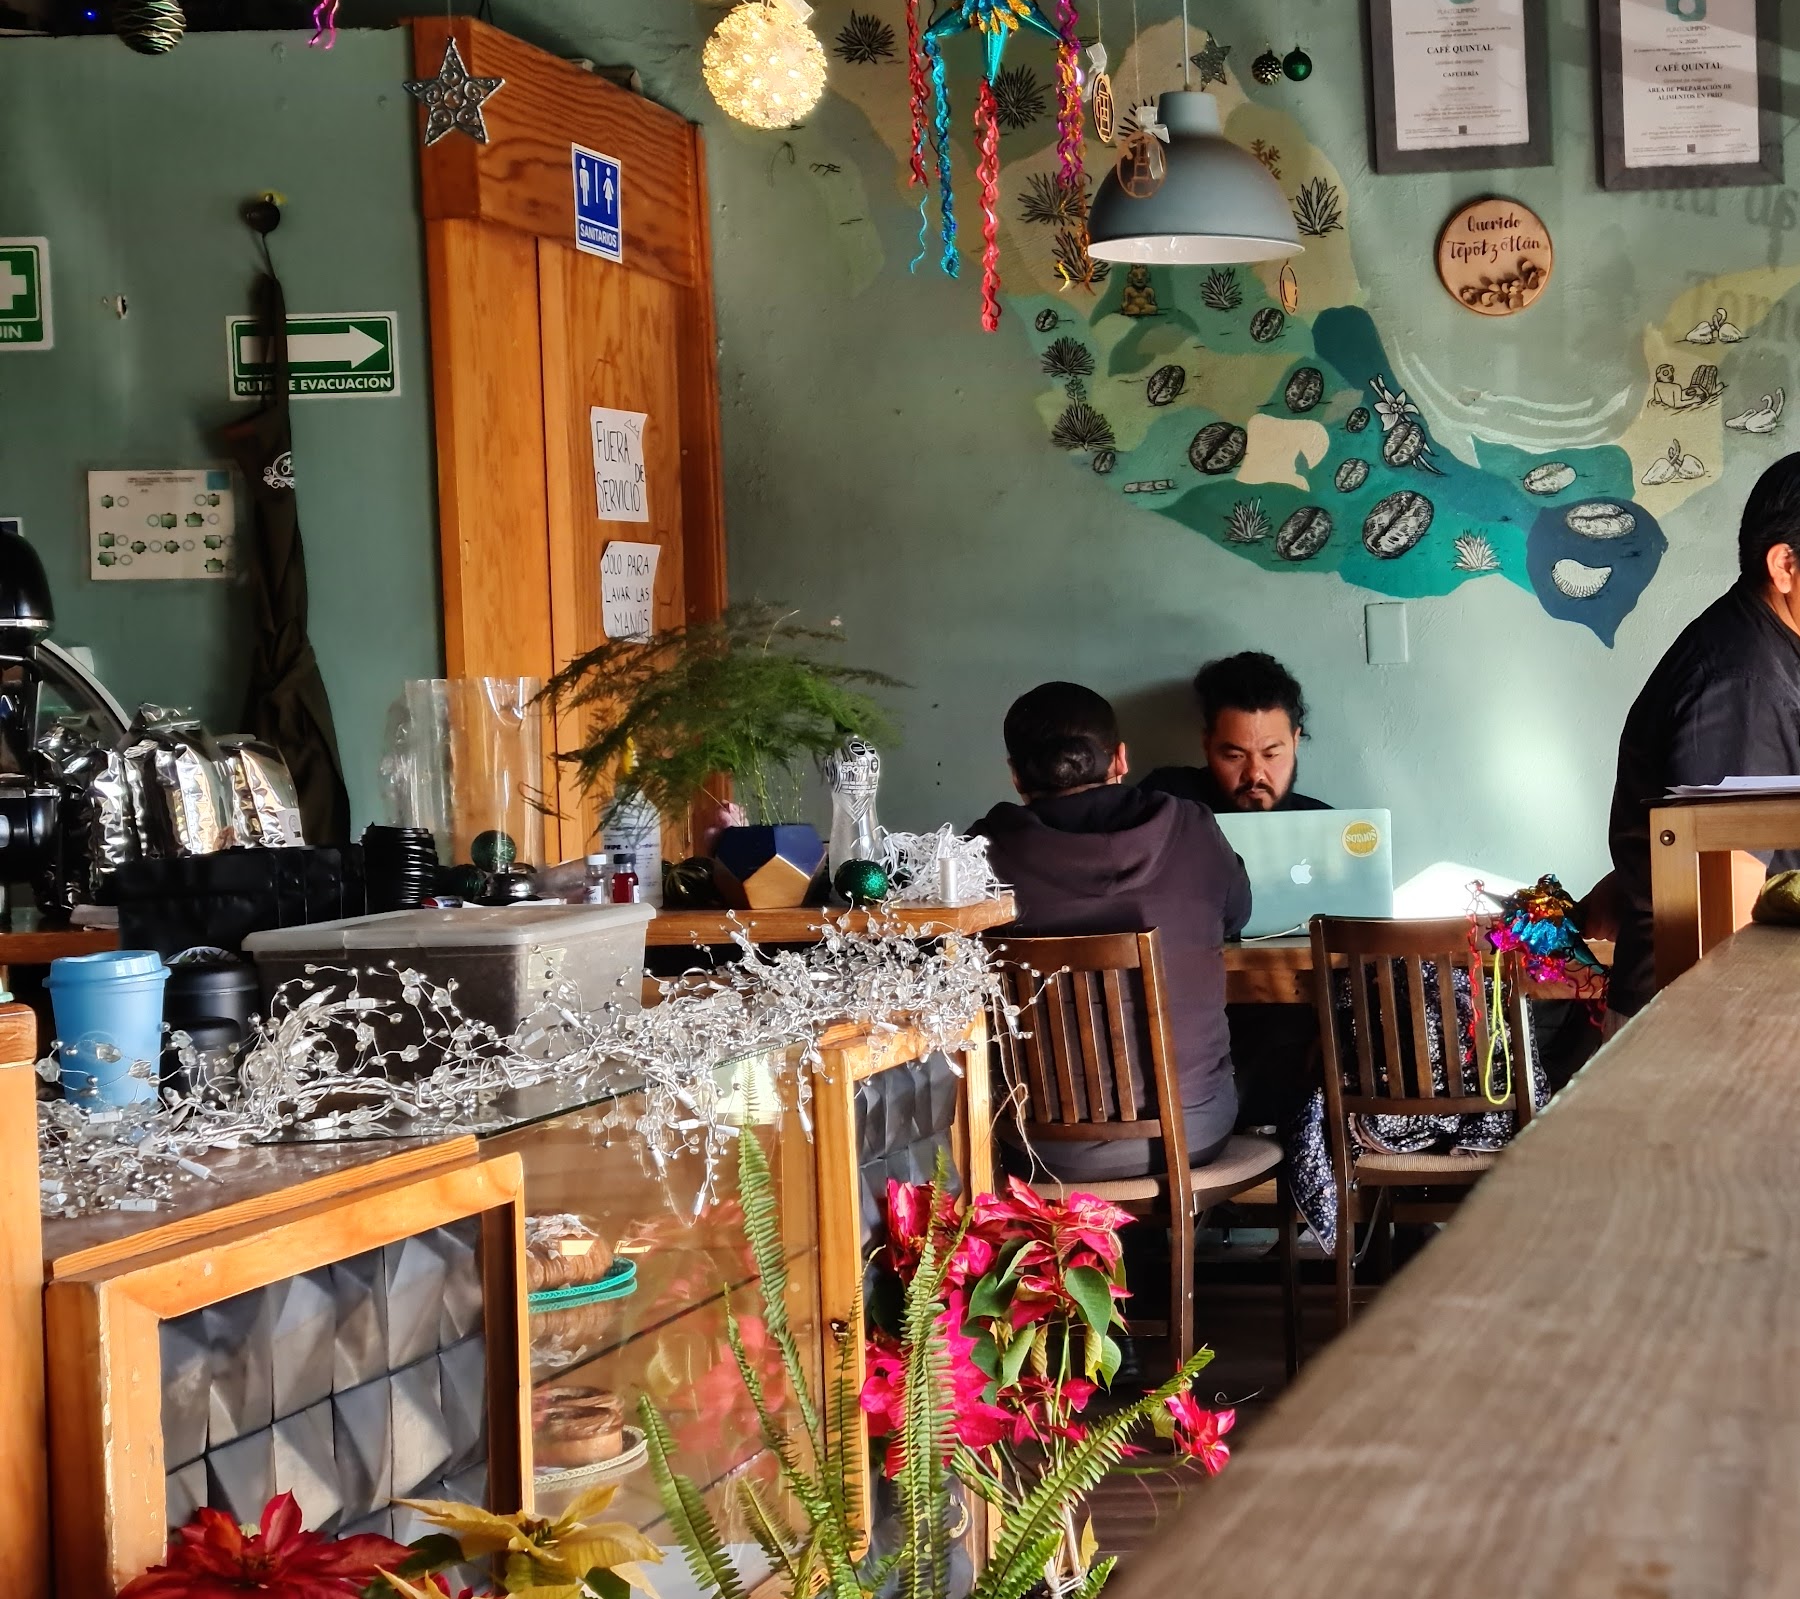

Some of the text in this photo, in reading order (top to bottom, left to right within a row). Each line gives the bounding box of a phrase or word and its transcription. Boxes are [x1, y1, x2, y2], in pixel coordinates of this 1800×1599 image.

[1427, 42, 1493, 54] CAFÉ QUINTAL
[1655, 61, 1722, 72] CAFÉ QUINTAL
[1468, 212, 1520, 232] Querido
[580, 223, 616, 248] SANITARIOS
[301, 375, 391, 390] EVACUACIÓN
[596, 421, 630, 465] FUERA
[635, 463, 644, 483] DE
[597, 472, 640, 512] SERVICIO
[627, 554, 649, 578] PARA
[605, 583, 649, 603] LAVAR LAS
[614, 609, 649, 637] MANOS
[841, 766, 868, 774] SPORT
